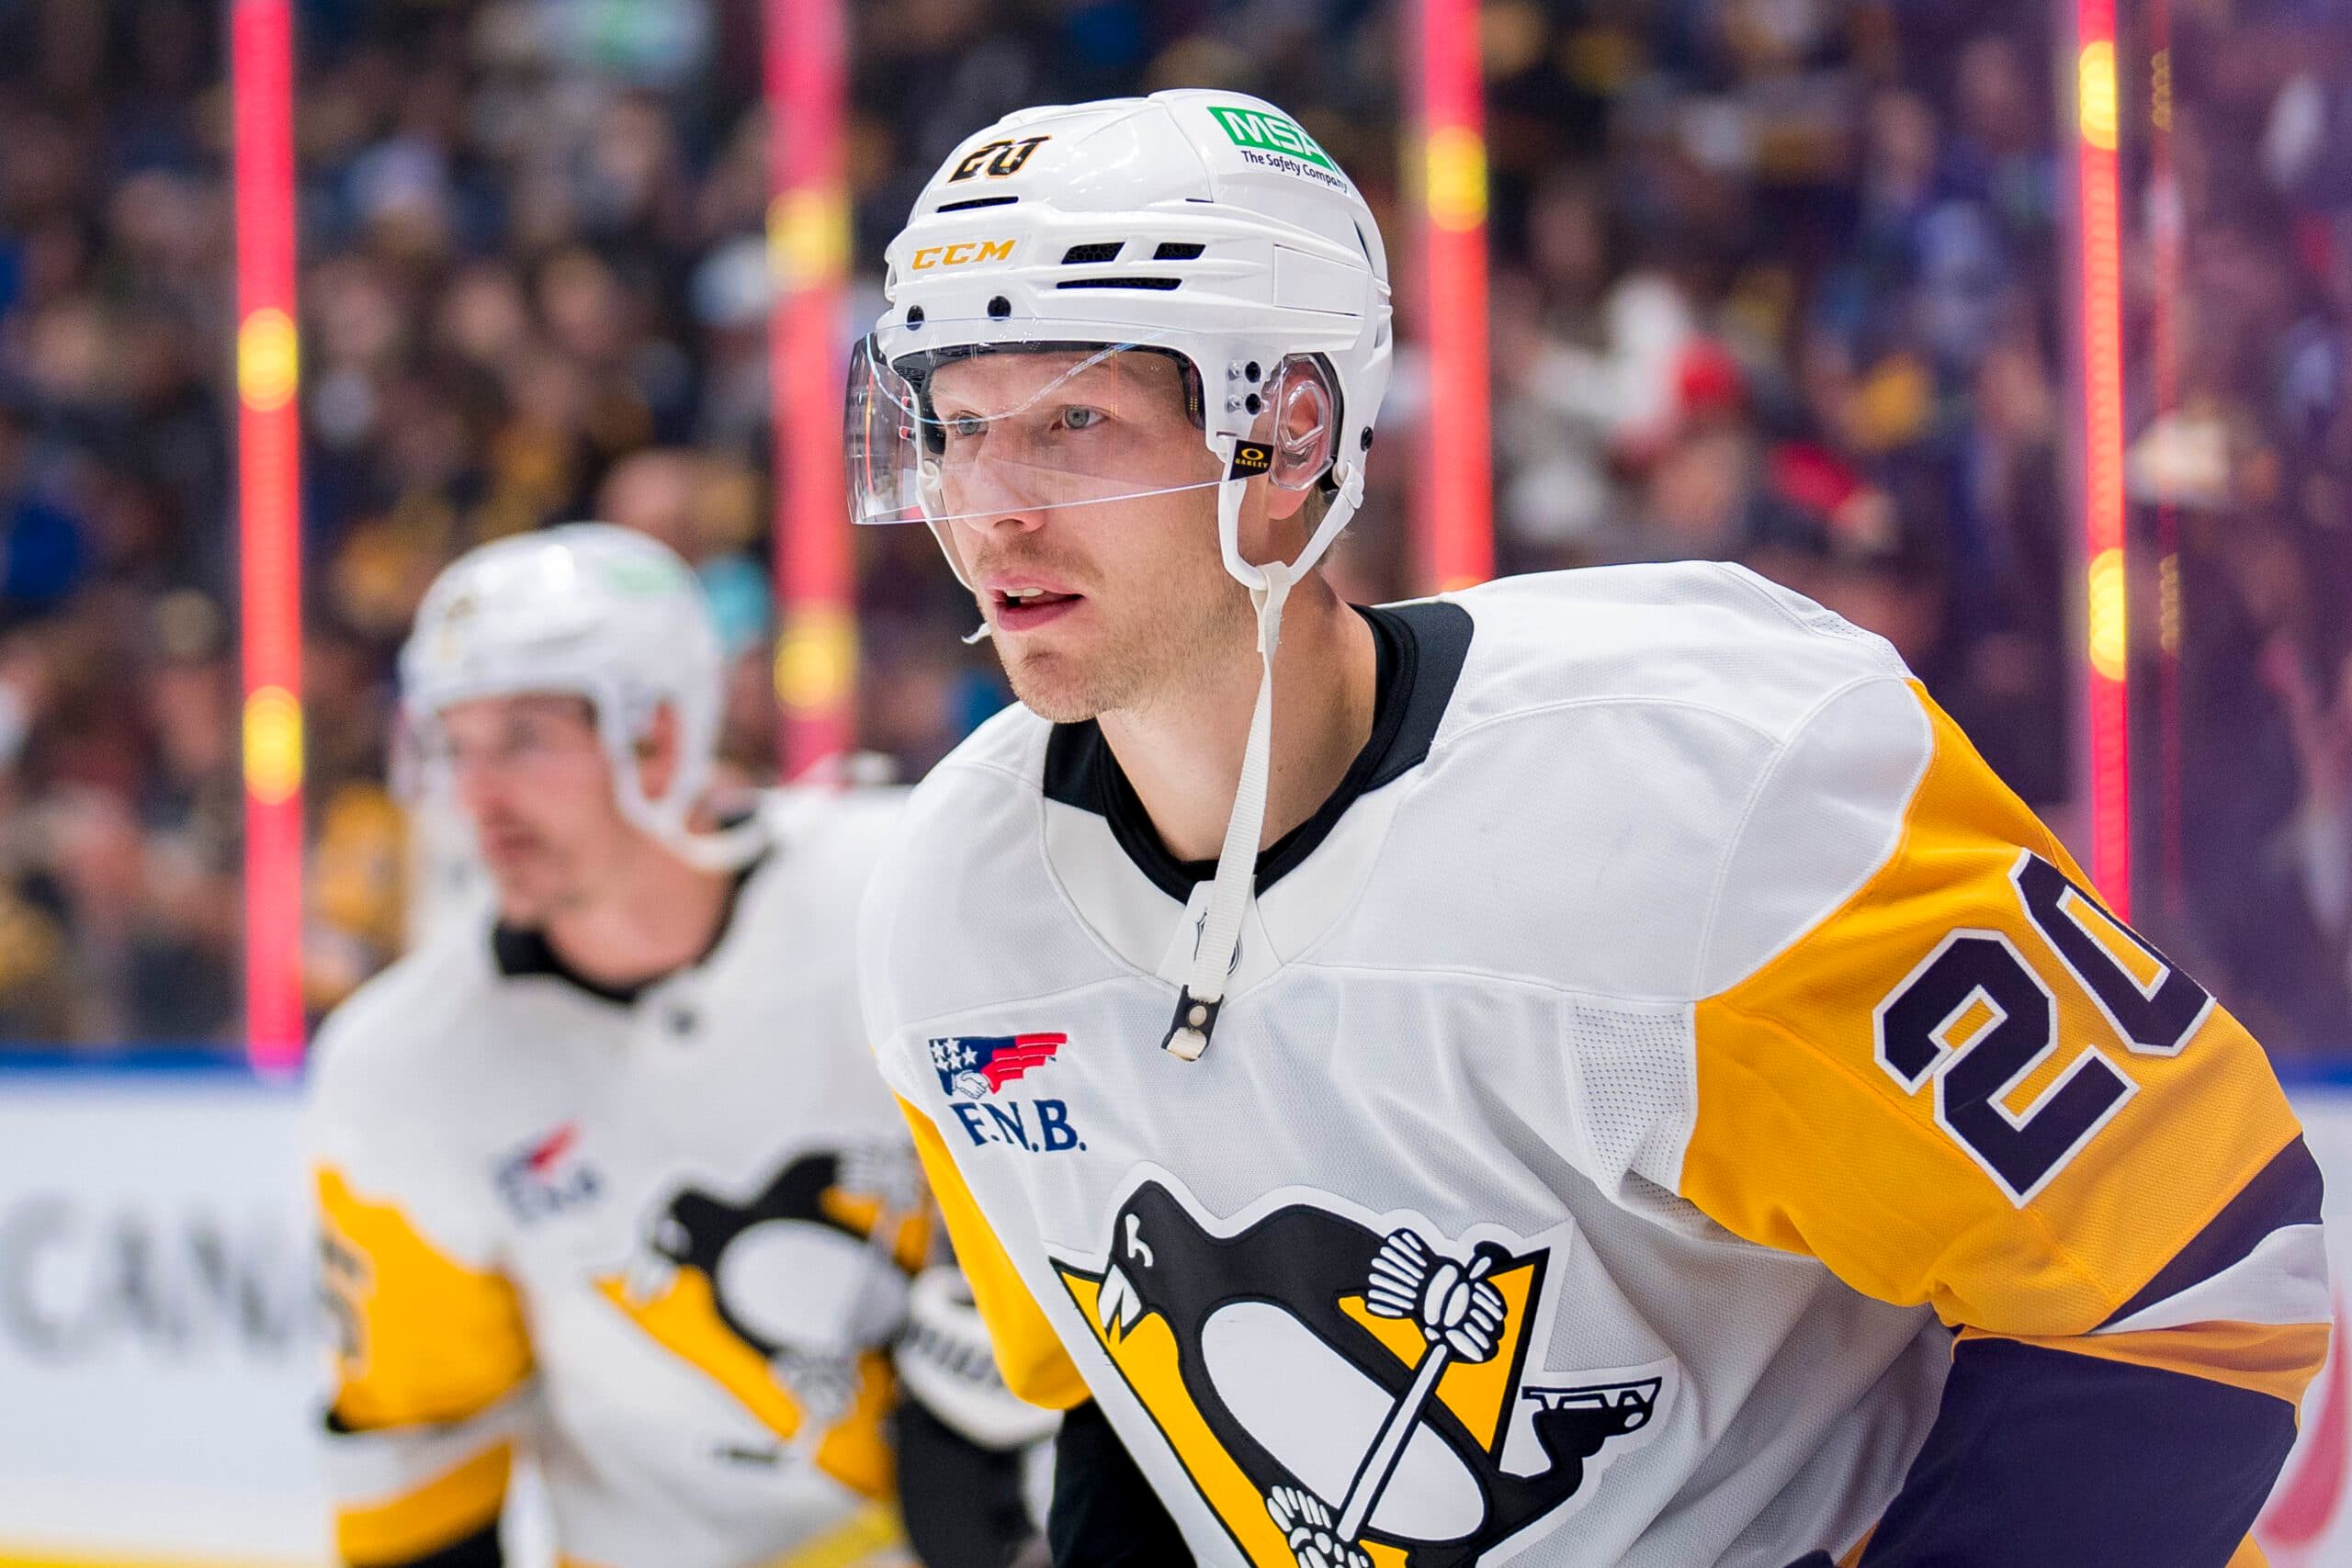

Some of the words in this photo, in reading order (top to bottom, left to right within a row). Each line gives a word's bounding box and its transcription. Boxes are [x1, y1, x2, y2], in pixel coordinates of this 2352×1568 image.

[1220, 110, 1320, 157] MSA
[944, 135, 1053, 186] 20
[1240, 150, 1265, 164] The
[1266, 153, 1301, 176] Safety
[1302, 164, 1348, 194] Company
[911, 239, 1016, 271] CCM
[1235, 457, 1269, 468] OAKLEY
[1872, 847, 2217, 1210] 20
[947, 1099, 1087, 1153] F.N.B.
